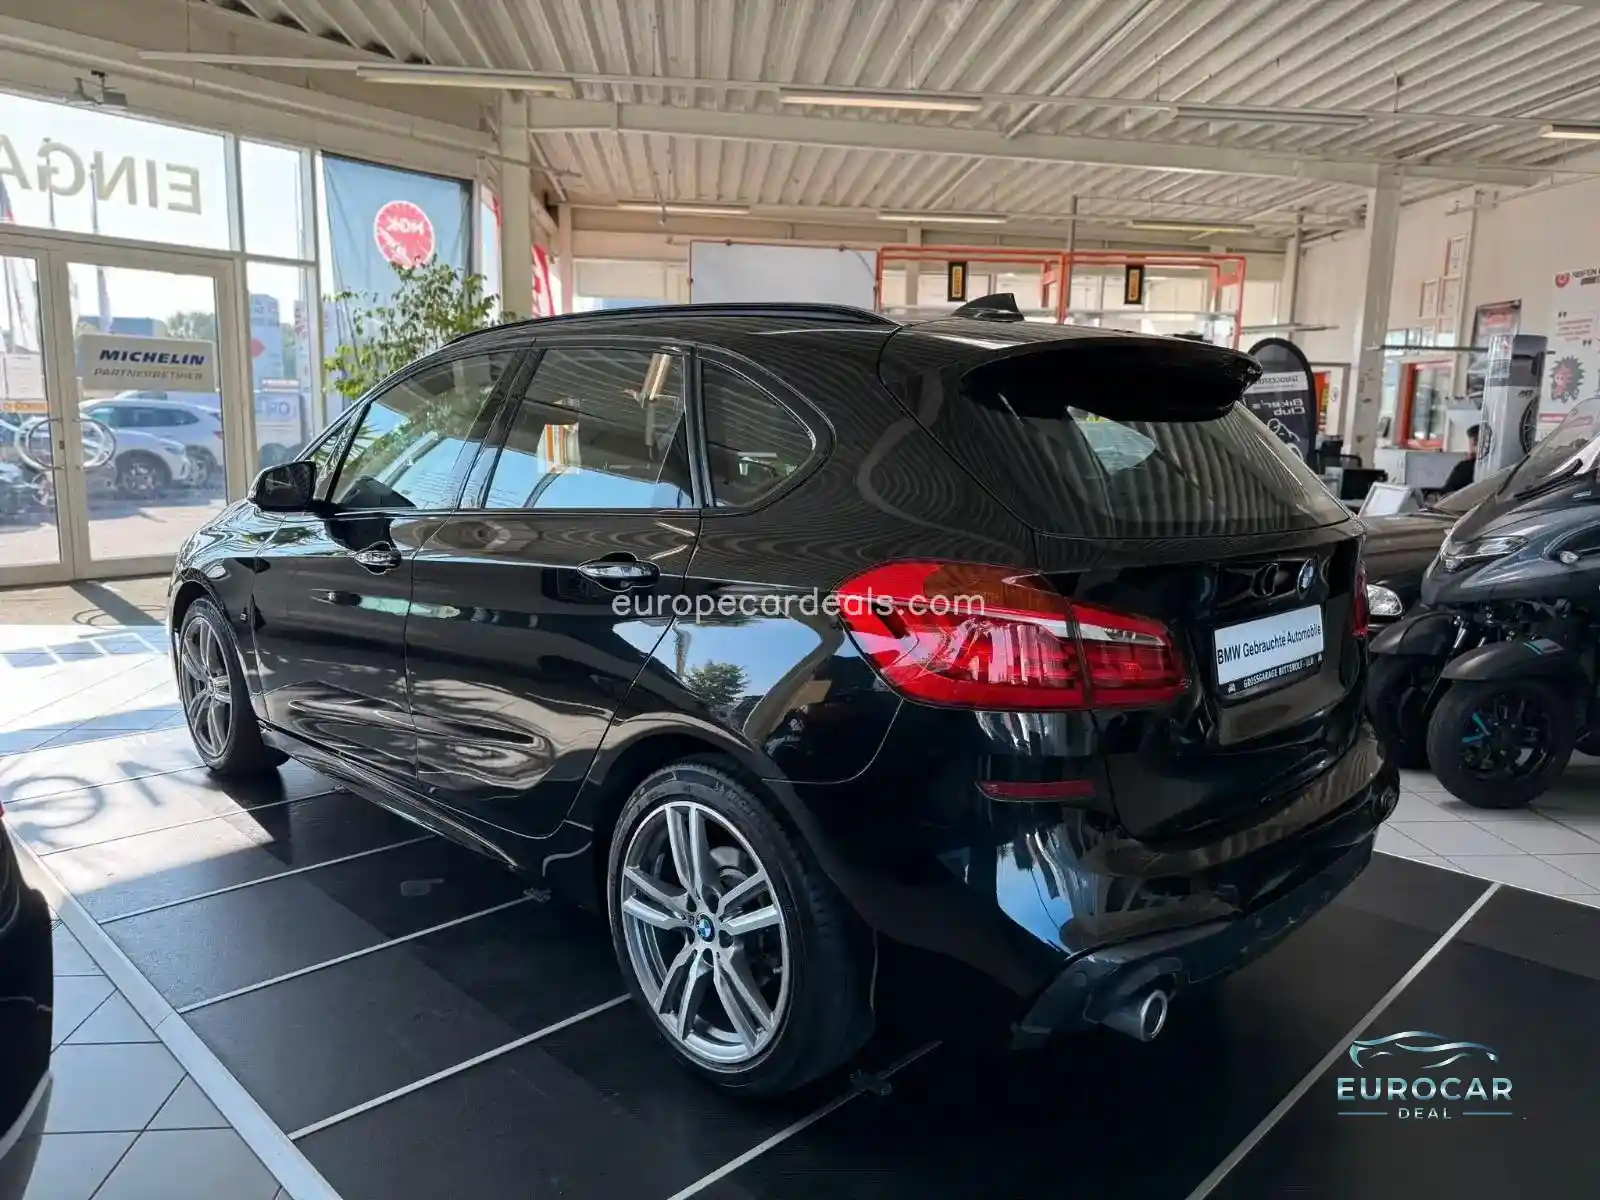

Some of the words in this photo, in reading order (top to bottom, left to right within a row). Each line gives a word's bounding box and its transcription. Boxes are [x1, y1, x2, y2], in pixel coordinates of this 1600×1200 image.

[99, 349, 205, 366] MICHELIN
[1217, 644, 1241, 665] BMW
[1242, 635, 1286, 658] Gebrauchte
[1287, 624, 1322, 645] Automobile
